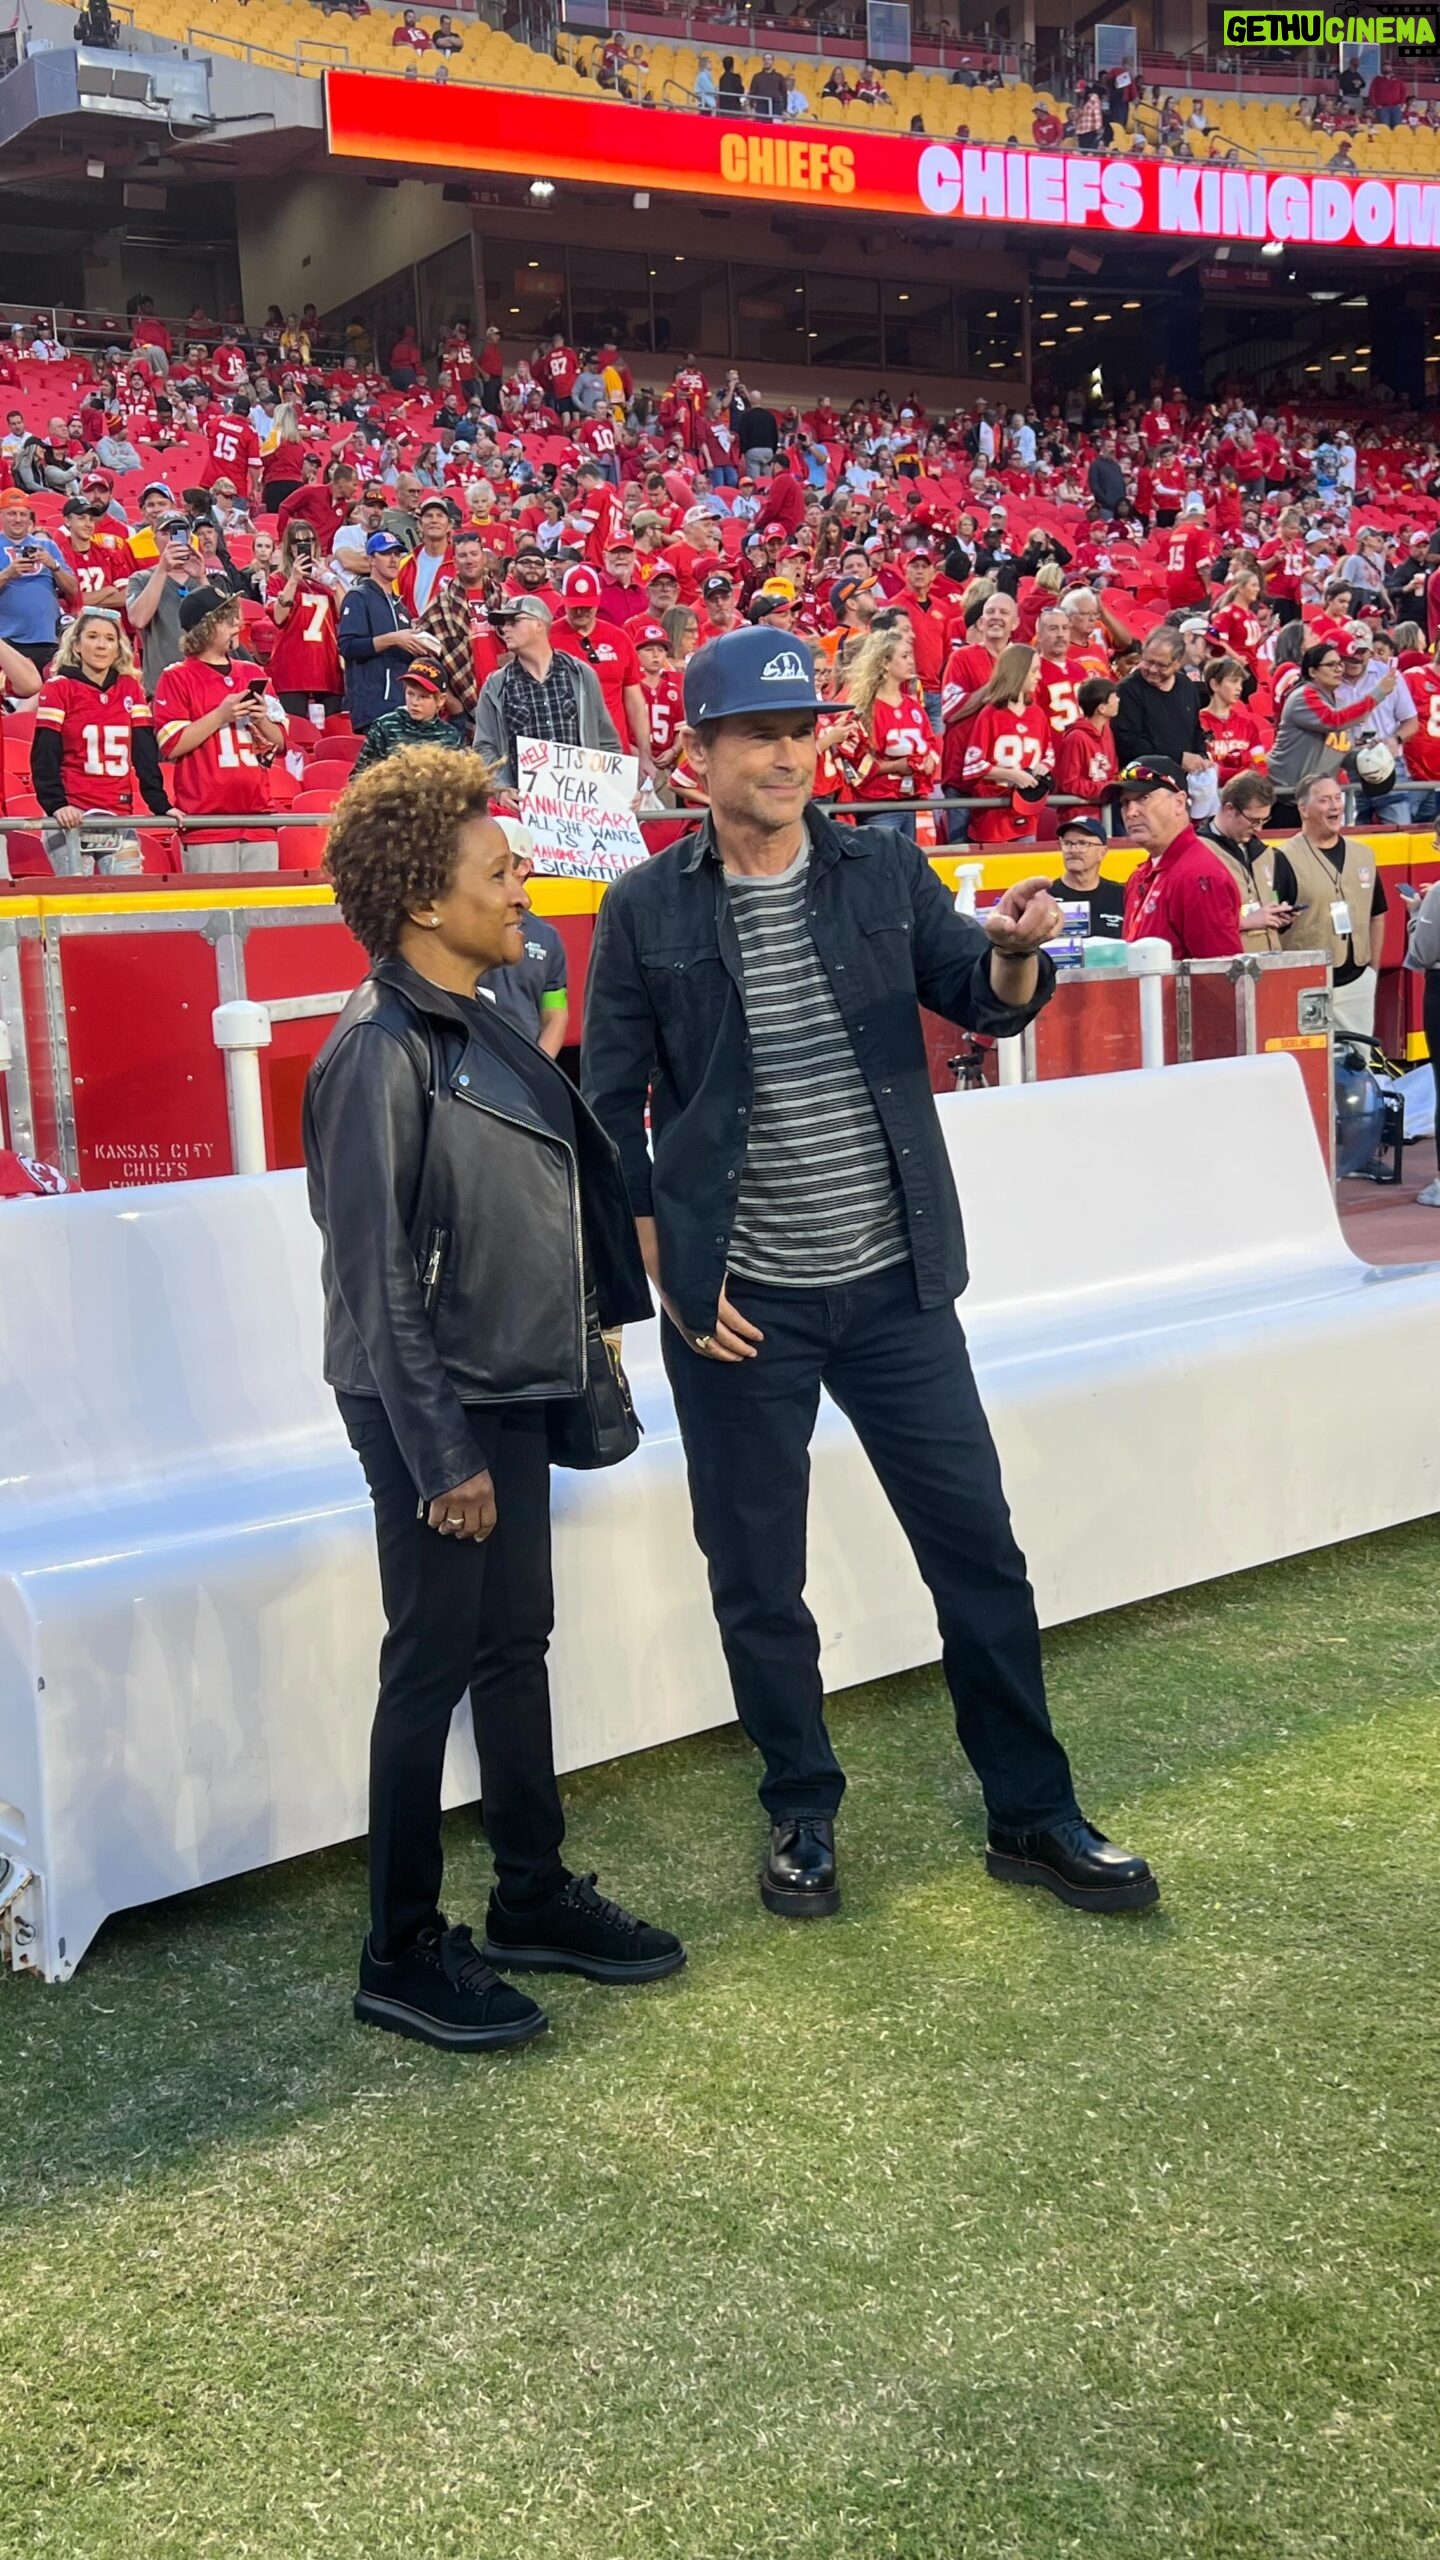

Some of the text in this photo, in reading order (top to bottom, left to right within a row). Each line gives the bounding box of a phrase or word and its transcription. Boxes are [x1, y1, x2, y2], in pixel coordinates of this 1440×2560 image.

[720, 133, 856, 194] CHIEFS
[471, 191, 500, 203] 121
[918, 145, 1440, 247] CHIEFS KINGDOM
[551, 356, 567, 377] 87
[734, 395, 745, 411] 3
[213, 432, 239, 461] 15
[592, 428, 615, 452] 10
[1168, 545, 1185, 571] 15
[1284, 553, 1304, 577] 15
[301, 593, 329, 642] 7
[1048, 681, 1081, 732] 5
[646, 704, 670, 744] 5
[82, 724, 130, 777] 15
[518, 742, 549, 767] HELP
[591, 753, 623, 775] OUR
[993, 734, 1042, 771] 87
[522, 769, 599, 804] 7 YEAR
[521, 793, 633, 830] ANNIVERSARY
[528, 814, 641, 845] ALL SHE WANTS
[556, 833, 607, 852] IS A
[94, 1142, 214, 1159] KANSAS CITY
[123, 1161, 188, 1177] CHIEFS
